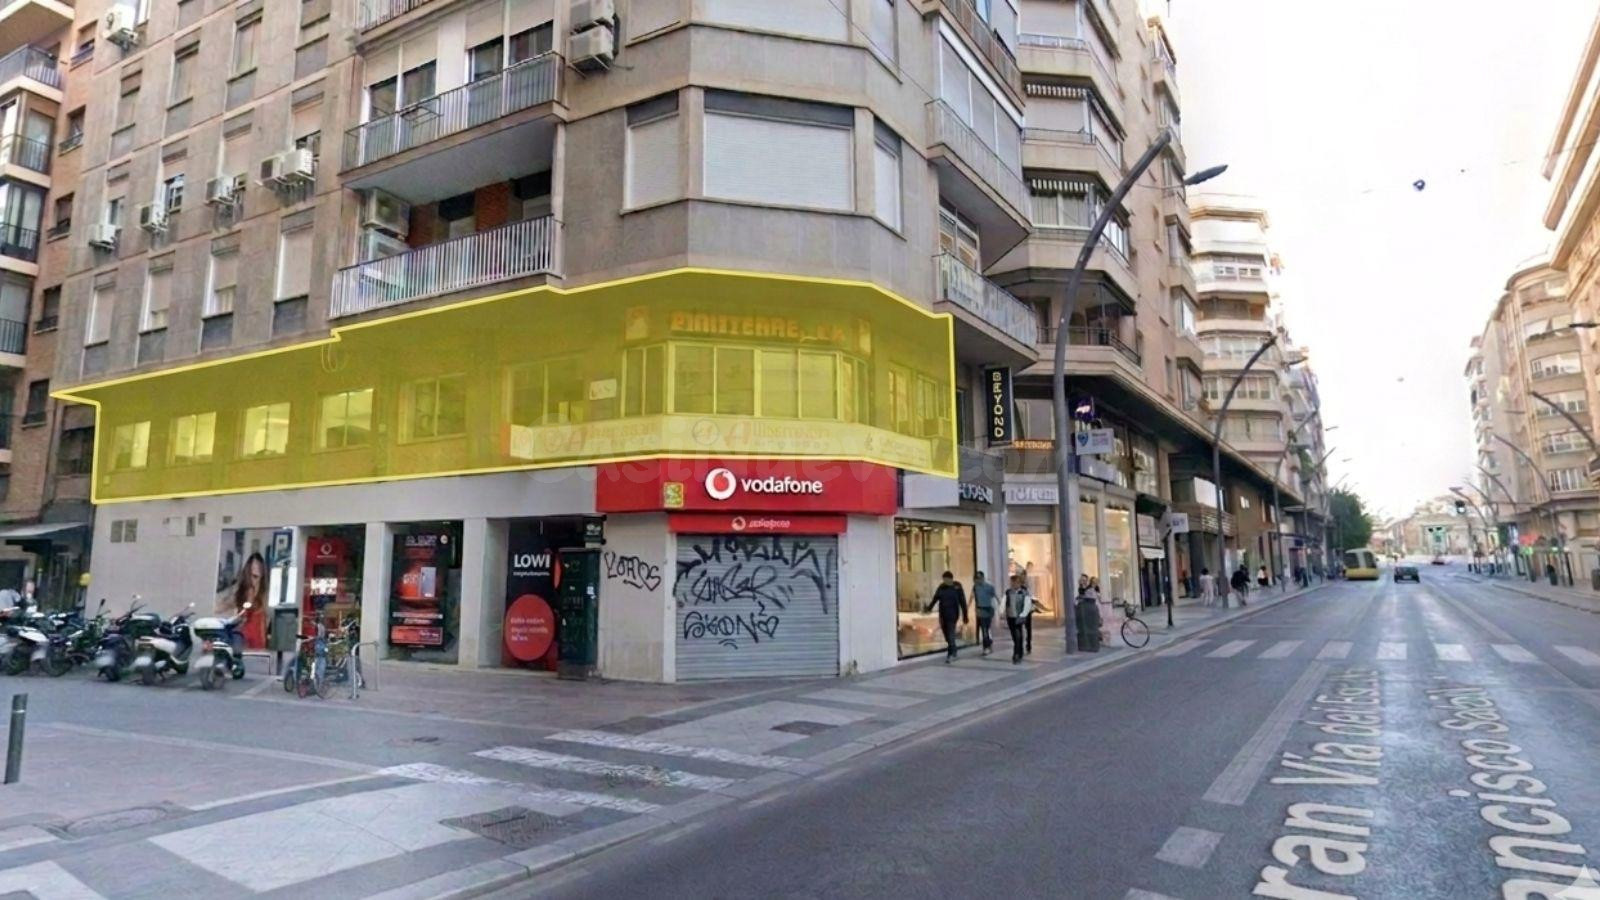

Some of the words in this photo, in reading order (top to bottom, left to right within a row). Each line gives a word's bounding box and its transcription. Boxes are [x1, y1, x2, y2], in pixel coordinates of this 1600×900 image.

[992, 371, 1005, 438] BEYOND
[741, 475, 824, 495] vodafone
[514, 554, 550, 568] LOWI
